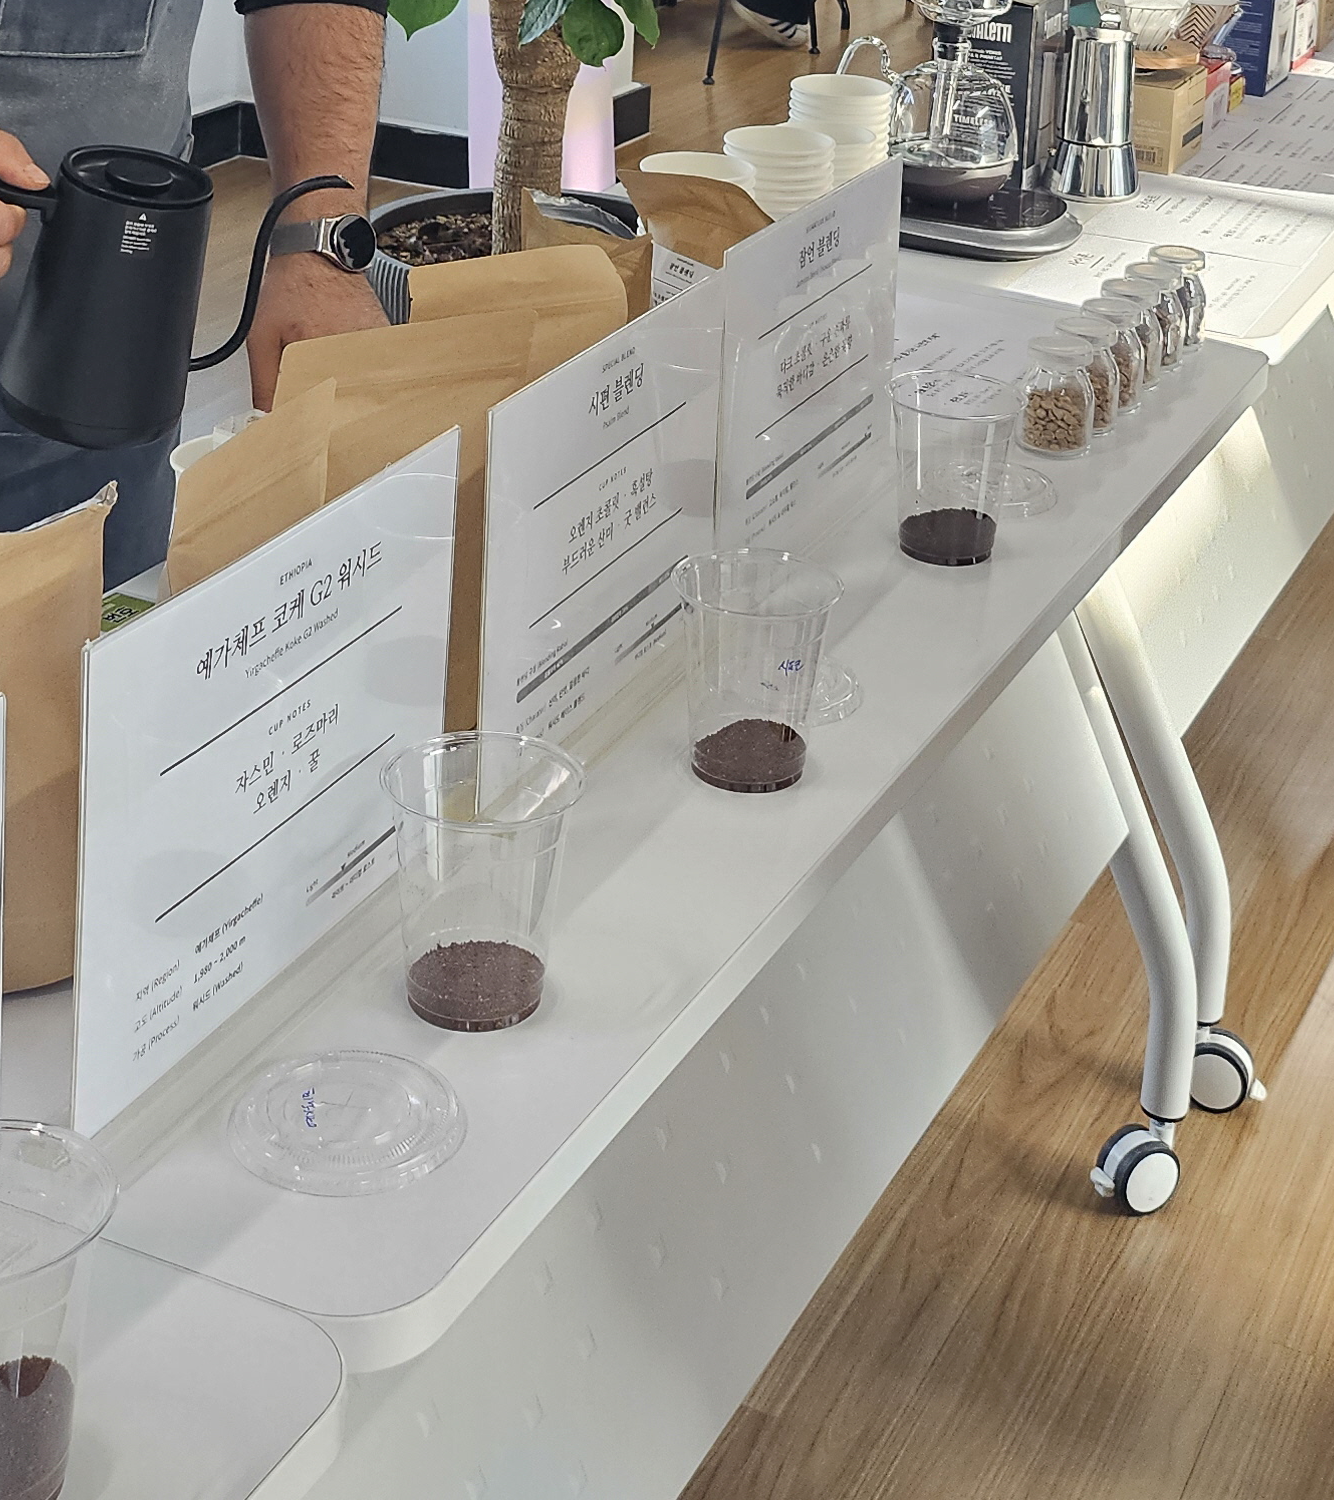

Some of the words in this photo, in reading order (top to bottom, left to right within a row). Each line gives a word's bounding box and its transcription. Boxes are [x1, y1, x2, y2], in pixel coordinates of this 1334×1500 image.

[816, 226, 840, 258] 블렌딩
[588, 384, 610, 416] 시편
[613, 363, 645, 403] 블렌딩
[562, 538, 596, 576] 부드러운
[598, 521, 614, 549] 산미
[568, 511, 593, 544] 오렌지
[279, 557, 313, 586] ETHIOPIA
[195, 616, 267, 681] 예가체프
[271, 588, 305, 634] 코케
[309, 573, 333, 607] G2
[337, 541, 383, 590] 워시드
[284, 633, 302, 651] Koke
[312, 607, 340, 632] Washed
[268, 718, 284, 736] CUP
[286, 699, 312, 723] NOTES
[234, 750, 274, 794] 자스민
[291, 703, 339, 755] 로즈마리
[252, 769, 291, 814] 오렌지
[307, 748, 321, 773] 꿀
[148, 1015, 180, 1050] (Process)
[212, 961, 244, 997] (Washed)
